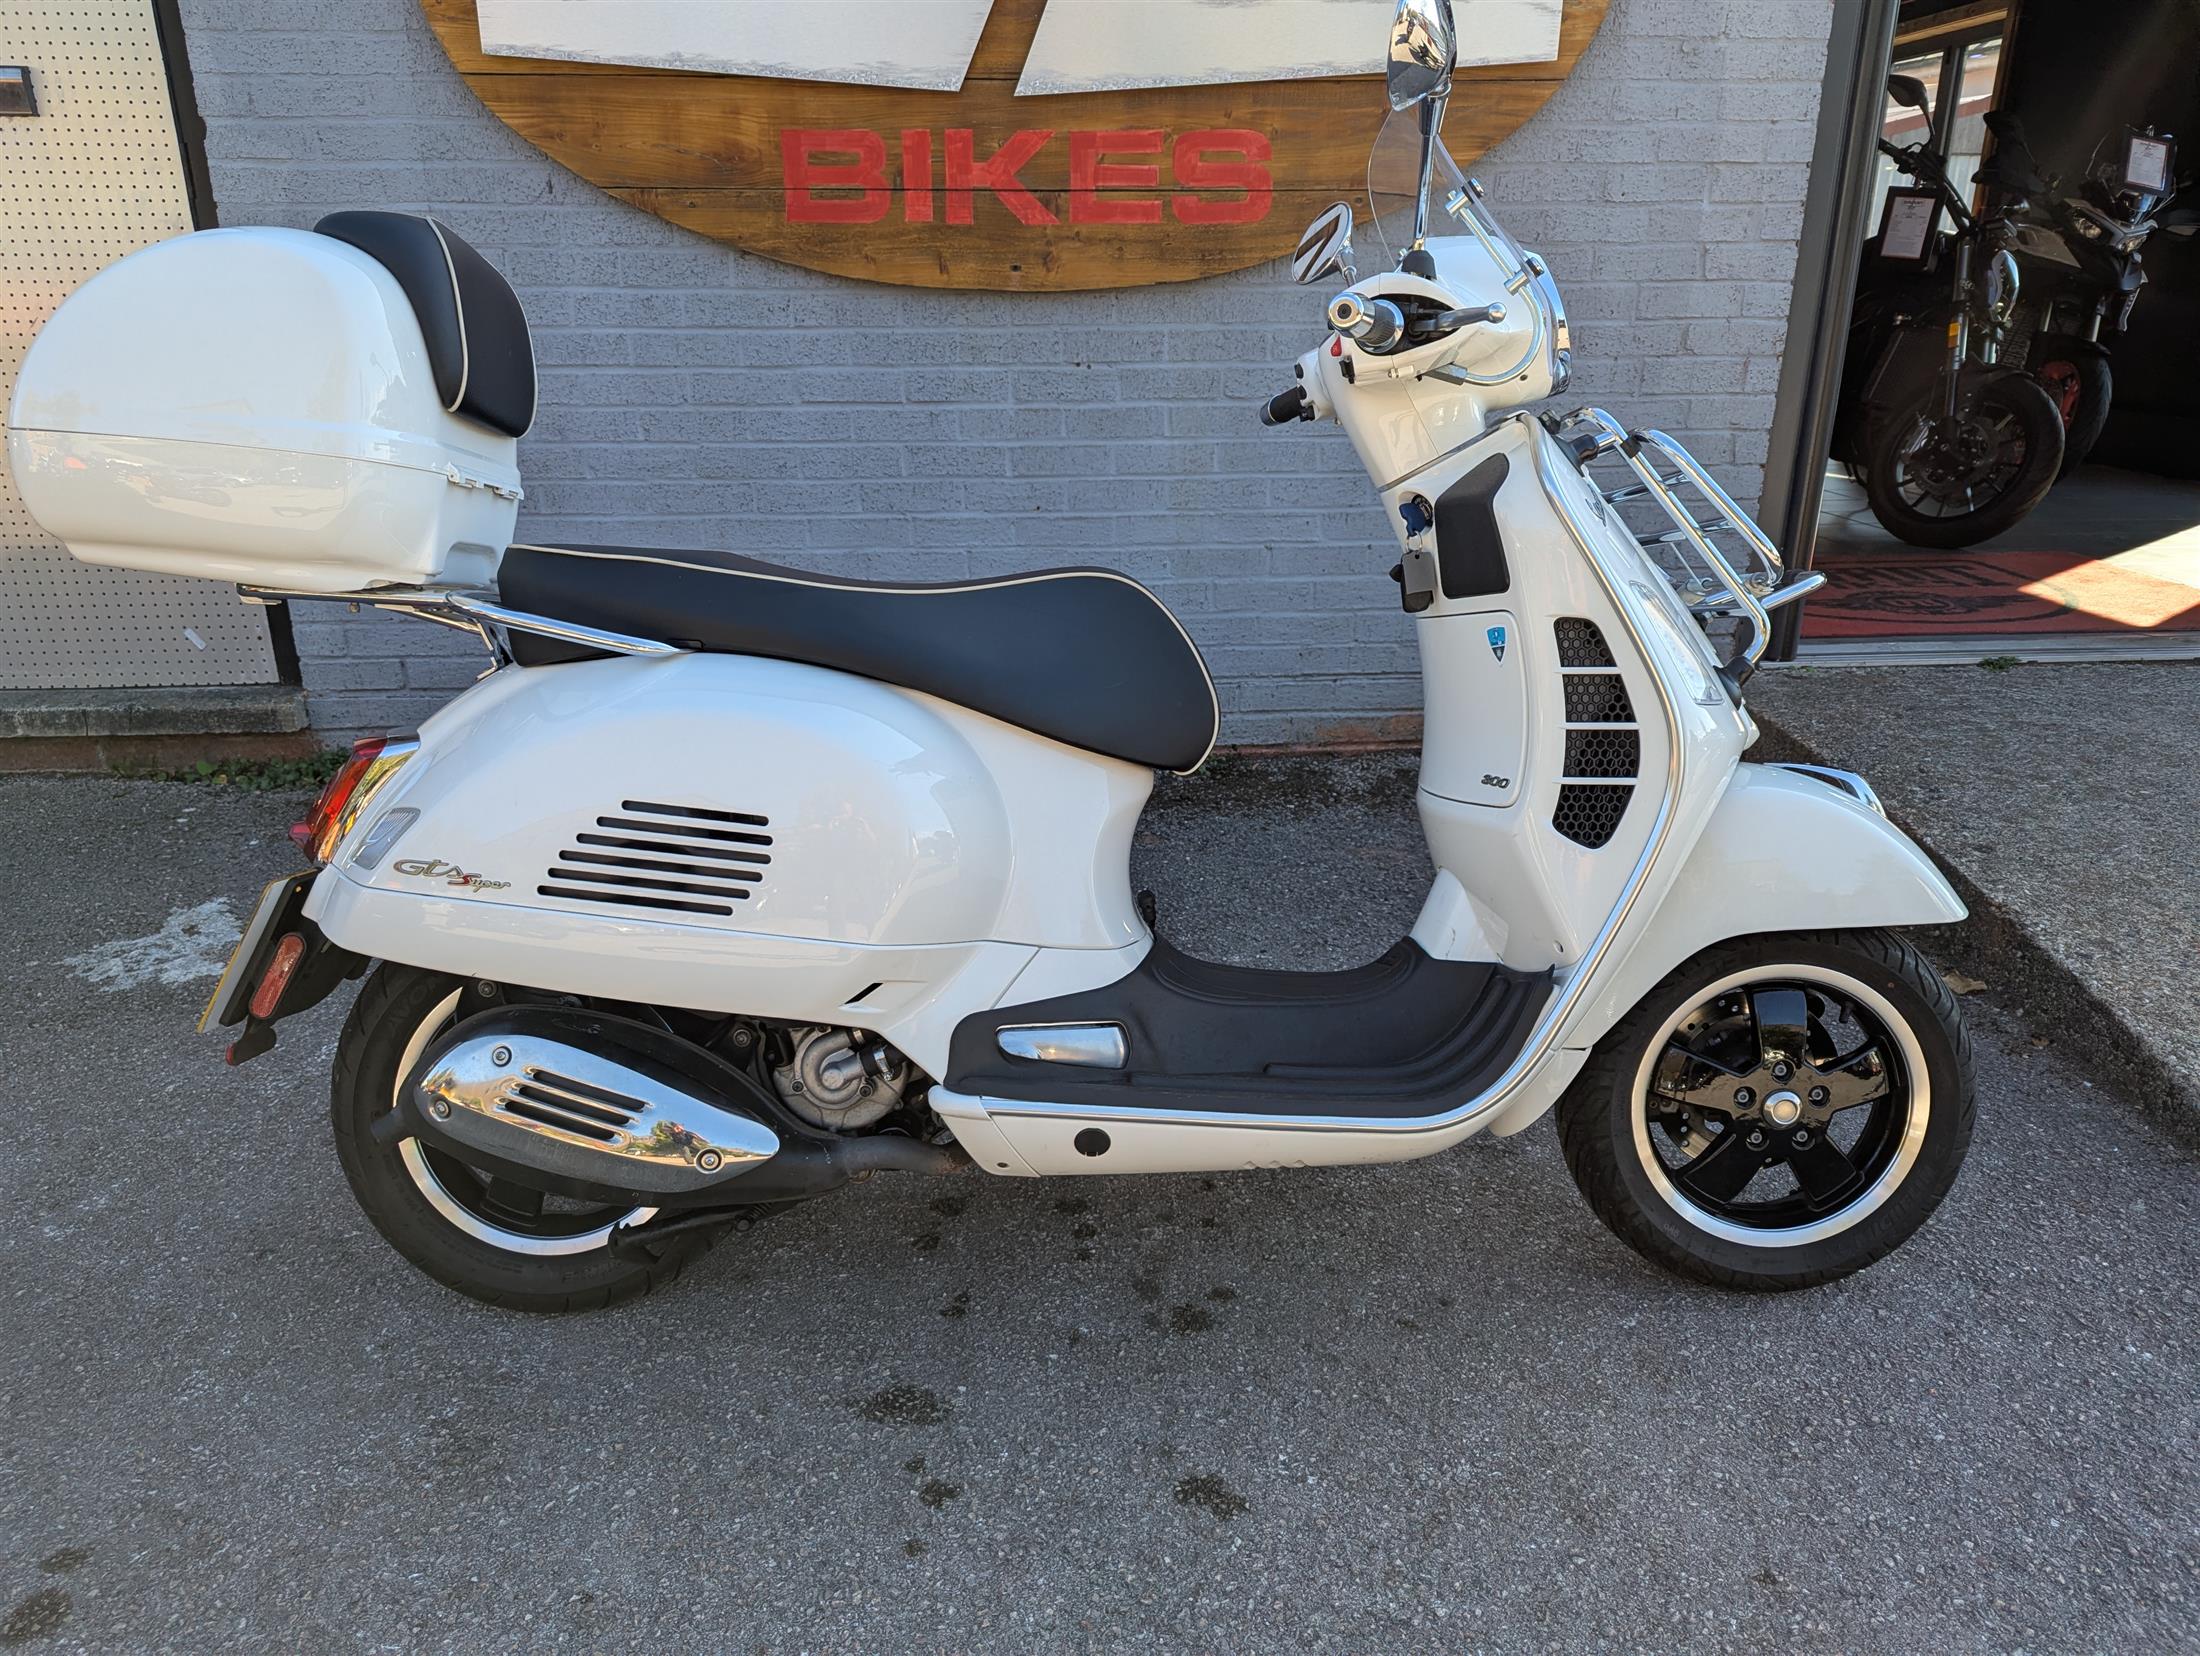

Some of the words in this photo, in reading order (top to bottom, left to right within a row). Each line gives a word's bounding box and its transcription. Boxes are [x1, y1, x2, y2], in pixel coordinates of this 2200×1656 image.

[780, 128, 1273, 225] BIKES
[1481, 774, 1511, 789] 300
[447, 873, 511, 893] Super
